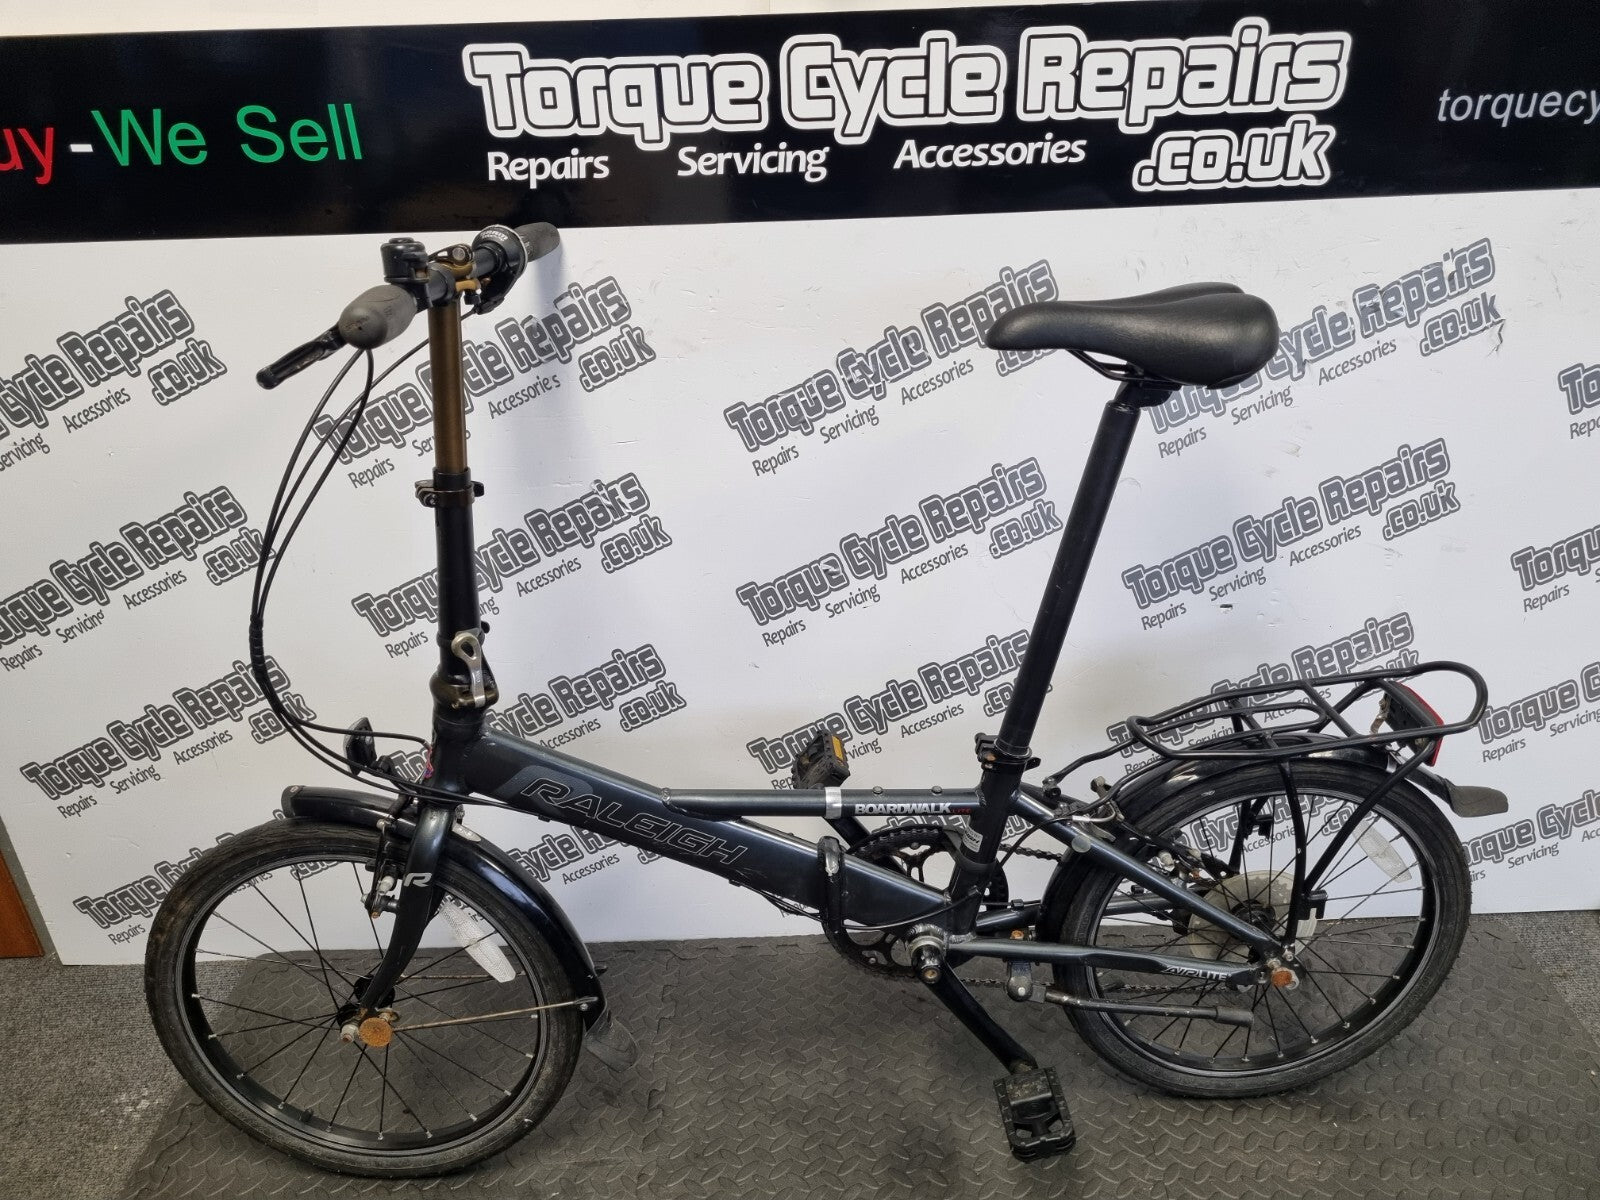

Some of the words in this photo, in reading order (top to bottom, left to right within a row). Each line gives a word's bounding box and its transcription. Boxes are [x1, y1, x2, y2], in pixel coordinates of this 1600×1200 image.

[462, 43, 769, 151] Torque
[780, 30, 1007, 145] Cycle
[1017, 17, 1352, 134] Repairs
[236, 103, 363, 163] Sell
[487, 147, 609, 190] Repairs
[677, 142, 830, 183] Servicing
[894, 132, 1087, 169] Accessories
[1132, 113, 1337, 192] .co.uk
[57, 289, 195, 378] Repairs
[495, 276, 632, 368] Repairs
[578, 324, 656, 393] .co.uk
[148, 338, 227, 406] .co.uk
[723, 369, 846, 452] Torque
[836, 325, 931, 401] Cycle
[1158, 426, 1207, 458] Repairs
[1231, 385, 1293, 425] Servicing
[1317, 338, 1397, 386] Accessories
[62, 387, 131, 434] Accessories
[347, 457, 395, 489] Repairs
[487, 371, 561, 420] Accessories
[751, 444, 799, 476] Repairs
[820, 405, 880, 444] Servicing
[901, 357, 974, 405] Accessories
[49, 541, 144, 606] Cycle
[120, 485, 248, 570] Repairs
[524, 472, 650, 556] Repairs
[600, 515, 673, 574] .co.uk
[736, 552, 849, 626] Torque
[839, 514, 929, 581] Cycle
[919, 456, 1047, 544] Repairs
[989, 499, 1063, 559] .co.uk
[1121, 535, 1237, 610] Torque
[1232, 497, 1322, 563] Cycle
[1319, 437, 1451, 526] Repairs
[1383, 481, 1460, 541] .co.uk
[384, 631, 429, 659] Repairs
[516, 555, 582, 598] Accessories
[762, 619, 806, 648] Repairs
[825, 583, 881, 619] Servicing
[900, 541, 969, 584] Accessories
[1141, 600, 1187, 631] Repairs
[1208, 565, 1267, 602] Servicing
[1288, 523, 1361, 567] Accessories
[1523, 584, 1570, 612] Repairs
[0, 644, 43, 672] Repairs
[55, 609, 105, 644] Servicing
[122, 567, 187, 610] Accessories
[1291, 611, 1413, 677] Repairs
[547, 643, 666, 719] Repairs
[618, 680, 687, 733] .co.uk
[844, 679, 926, 736] Cycle
[20, 736, 127, 801] Torque
[107, 704, 192, 770] Cycle
[900, 702, 964, 738] Accessories
[1482, 738, 1527, 763] Repairs
[57, 793, 98, 820] Repairs
[110, 763, 161, 795] Servicing
[172, 728, 233, 765] Accessories
[854, 803, 951, 815] BOARDWALK
[520, 778, 748, 866] RALEIGH
[1507, 842, 1559, 869] Servicing
[73, 874, 165, 930] Torque
[562, 853, 620, 885] Accessories
[108, 923, 145, 945] Repairs
